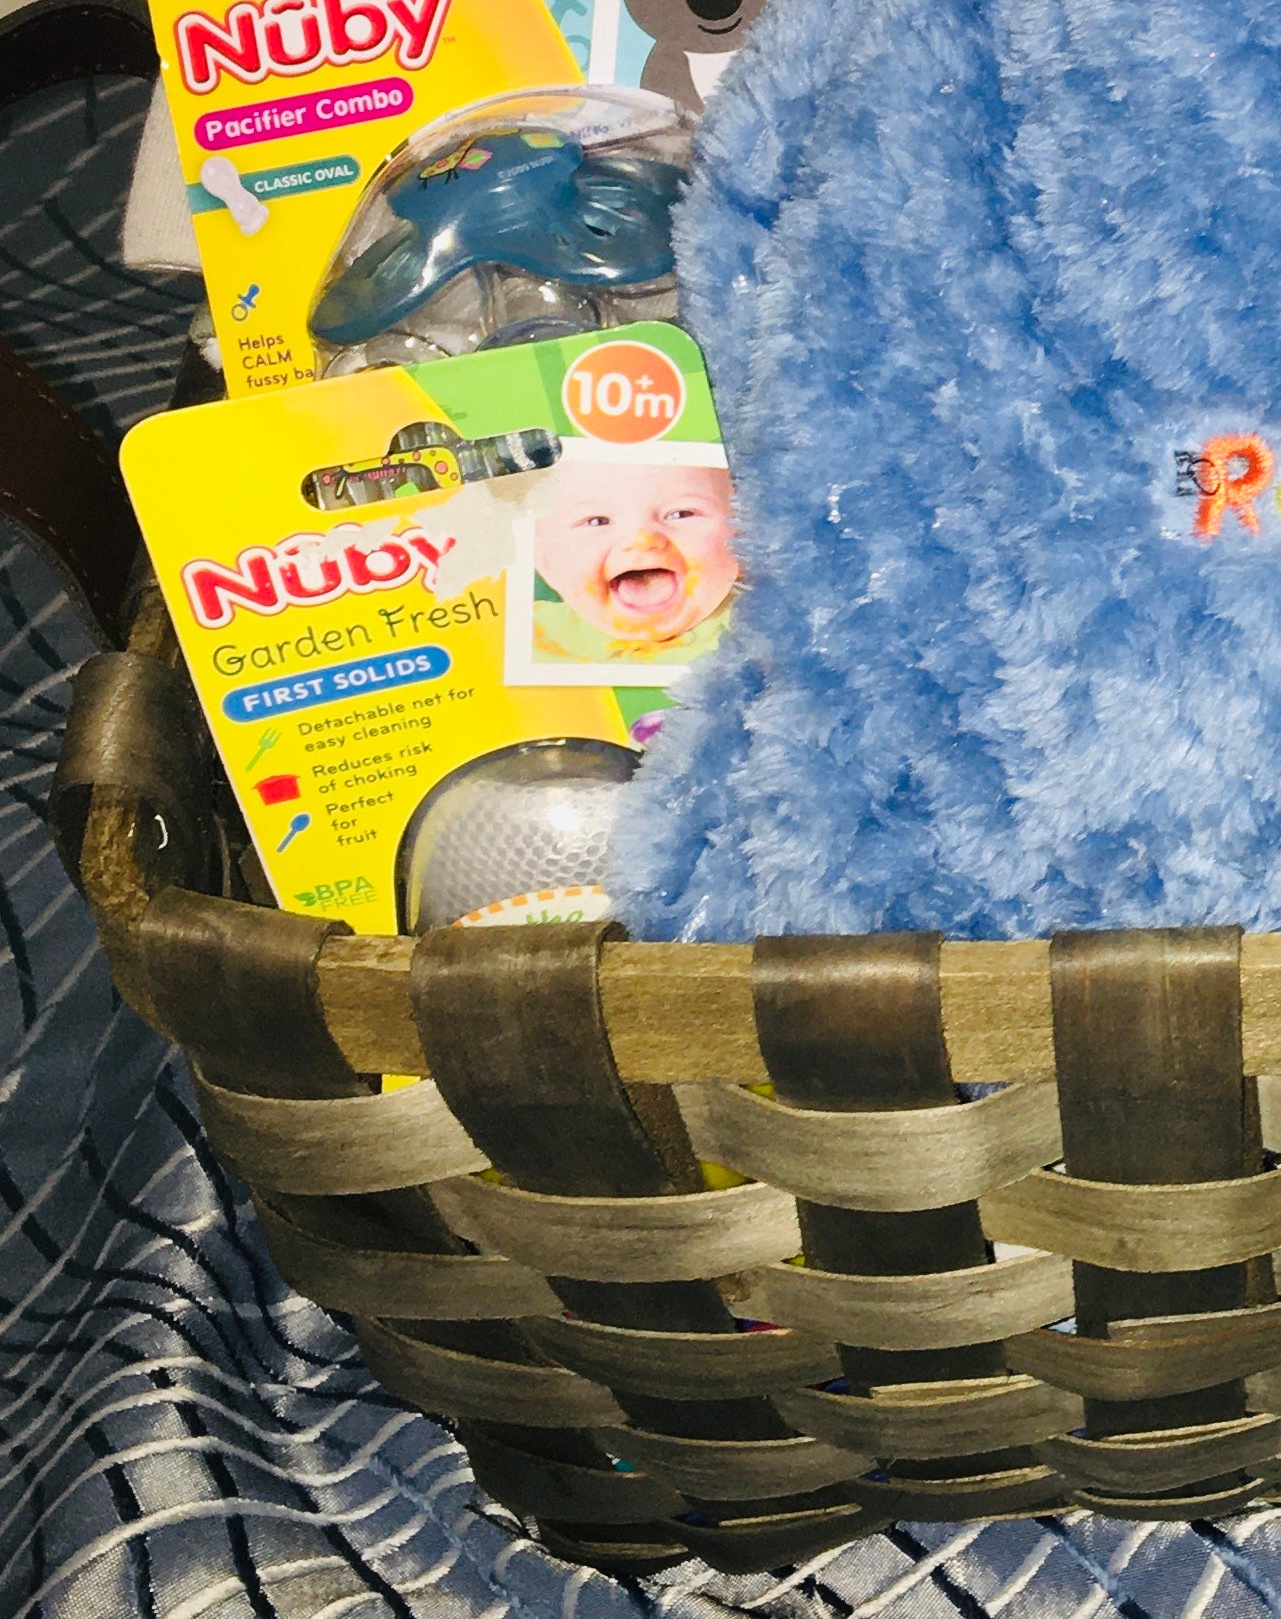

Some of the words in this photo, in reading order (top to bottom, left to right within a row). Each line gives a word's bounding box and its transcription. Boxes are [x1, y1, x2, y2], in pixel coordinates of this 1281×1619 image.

[204, 104, 307, 142] Pacifier
[315, 87, 404, 120] Combo
[253, 172, 313, 194] CLASSIC
[314, 164, 355, 185] OVAL
[238, 334, 285, 351] Helps
[242, 349, 293, 370] CALM
[246, 372, 289, 388] fussy
[212, 625, 373, 677] Garden
[377, 591, 499, 639] Fresh
[242, 679, 324, 713] FIRST
[332, 654, 432, 691] SOLIDS
[297, 702, 406, 737] Detachable
[411, 693, 443, 710] net
[447, 686, 476, 702] for
[304, 735, 346, 753] easy
[352, 715, 433, 742] cleaning
[311, 751, 394, 779] Reduces
[399, 741, 434, 759] risk
[317, 781, 338, 795] of
[344, 763, 418, 789] choking
[325, 790, 395, 817] Perfect
[331, 817, 359, 832] for
[336, 828, 378, 848] fruit
[314, 876, 374, 901] BPA
[320, 889, 381, 912] FREE
